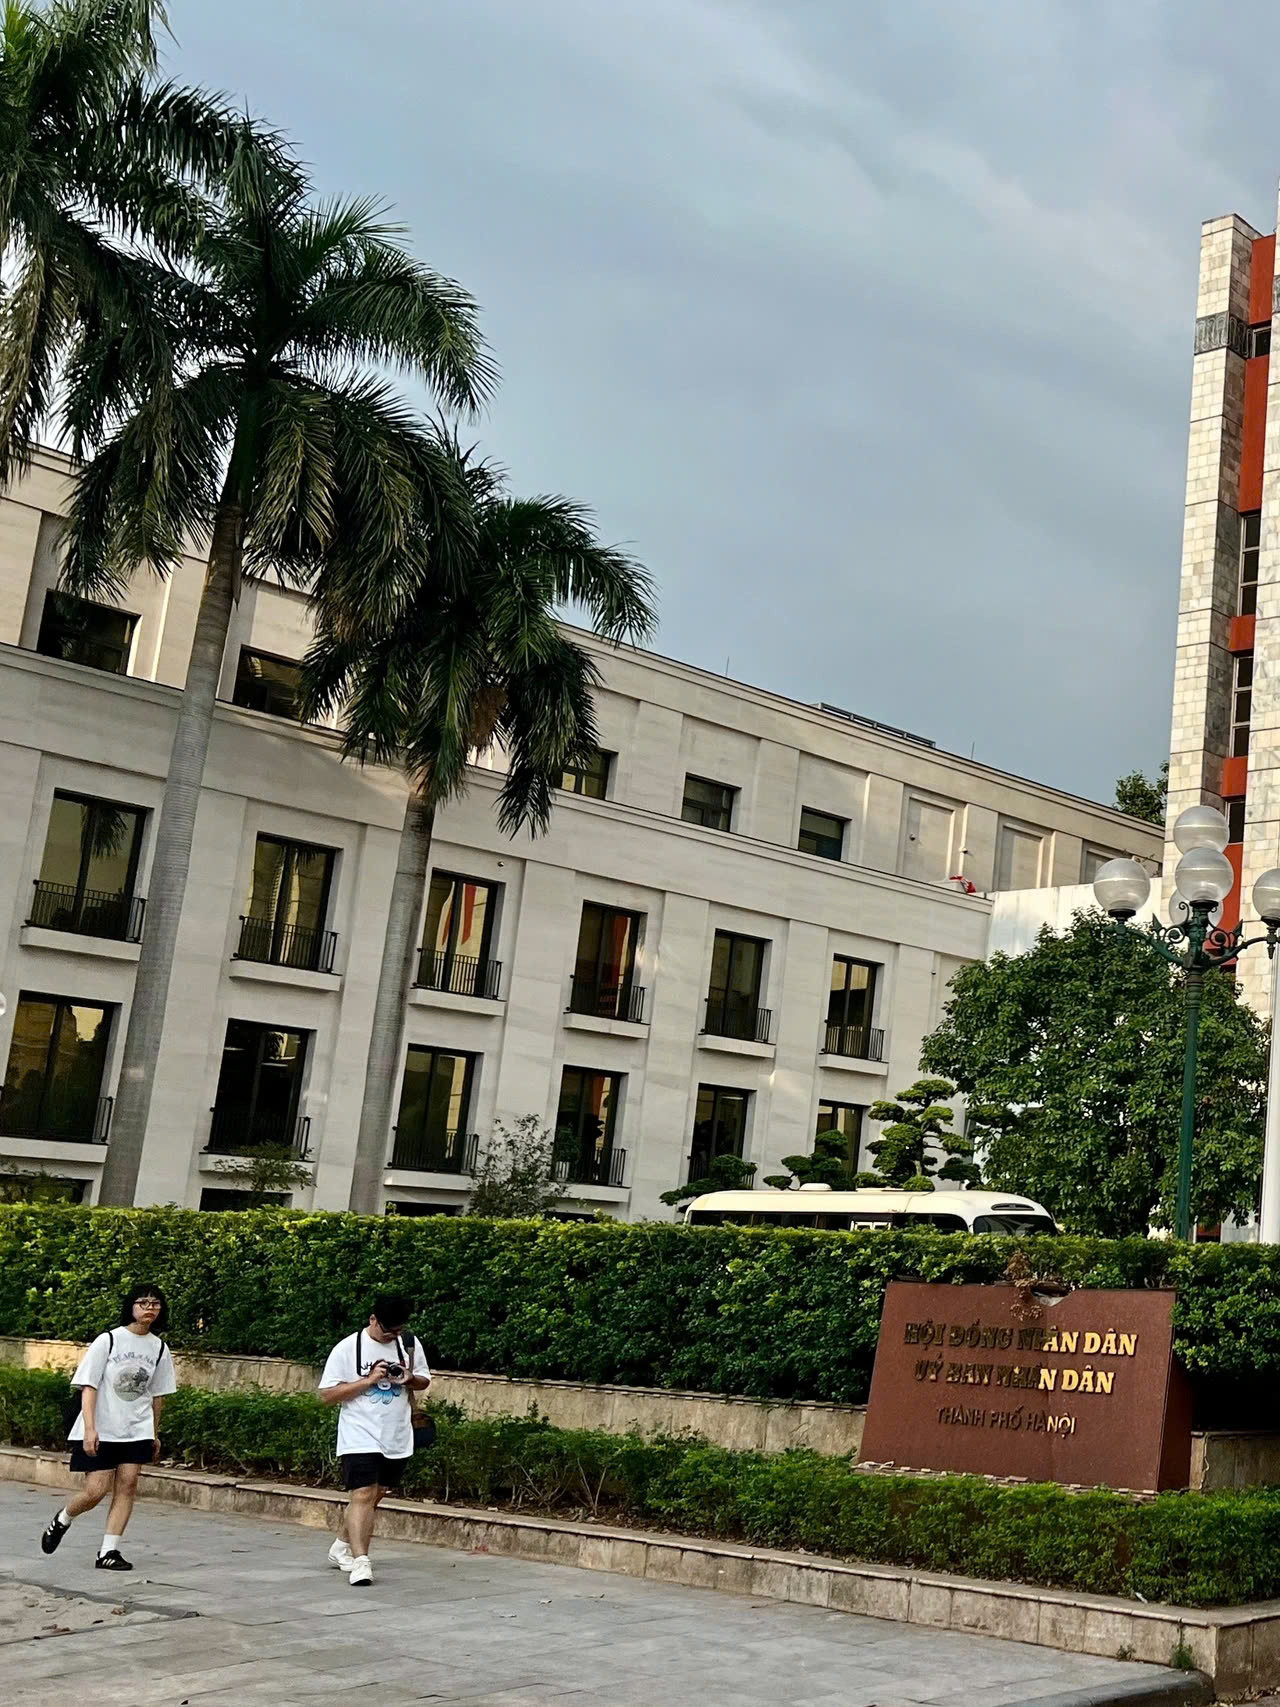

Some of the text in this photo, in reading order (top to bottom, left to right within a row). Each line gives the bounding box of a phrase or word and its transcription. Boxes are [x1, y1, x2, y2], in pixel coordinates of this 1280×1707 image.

[904, 1320, 945, 1350] HỘI
[1016, 1325, 1079, 1353] NHÂN
[1083, 1328, 1138, 1357] DÂN
[946, 1362, 994, 1386] BAN
[1061, 1364, 1115, 1395] DÂN
[989, 1405, 1024, 1431] PHỐ
[1047, 1412, 1077, 1439] NỘI
